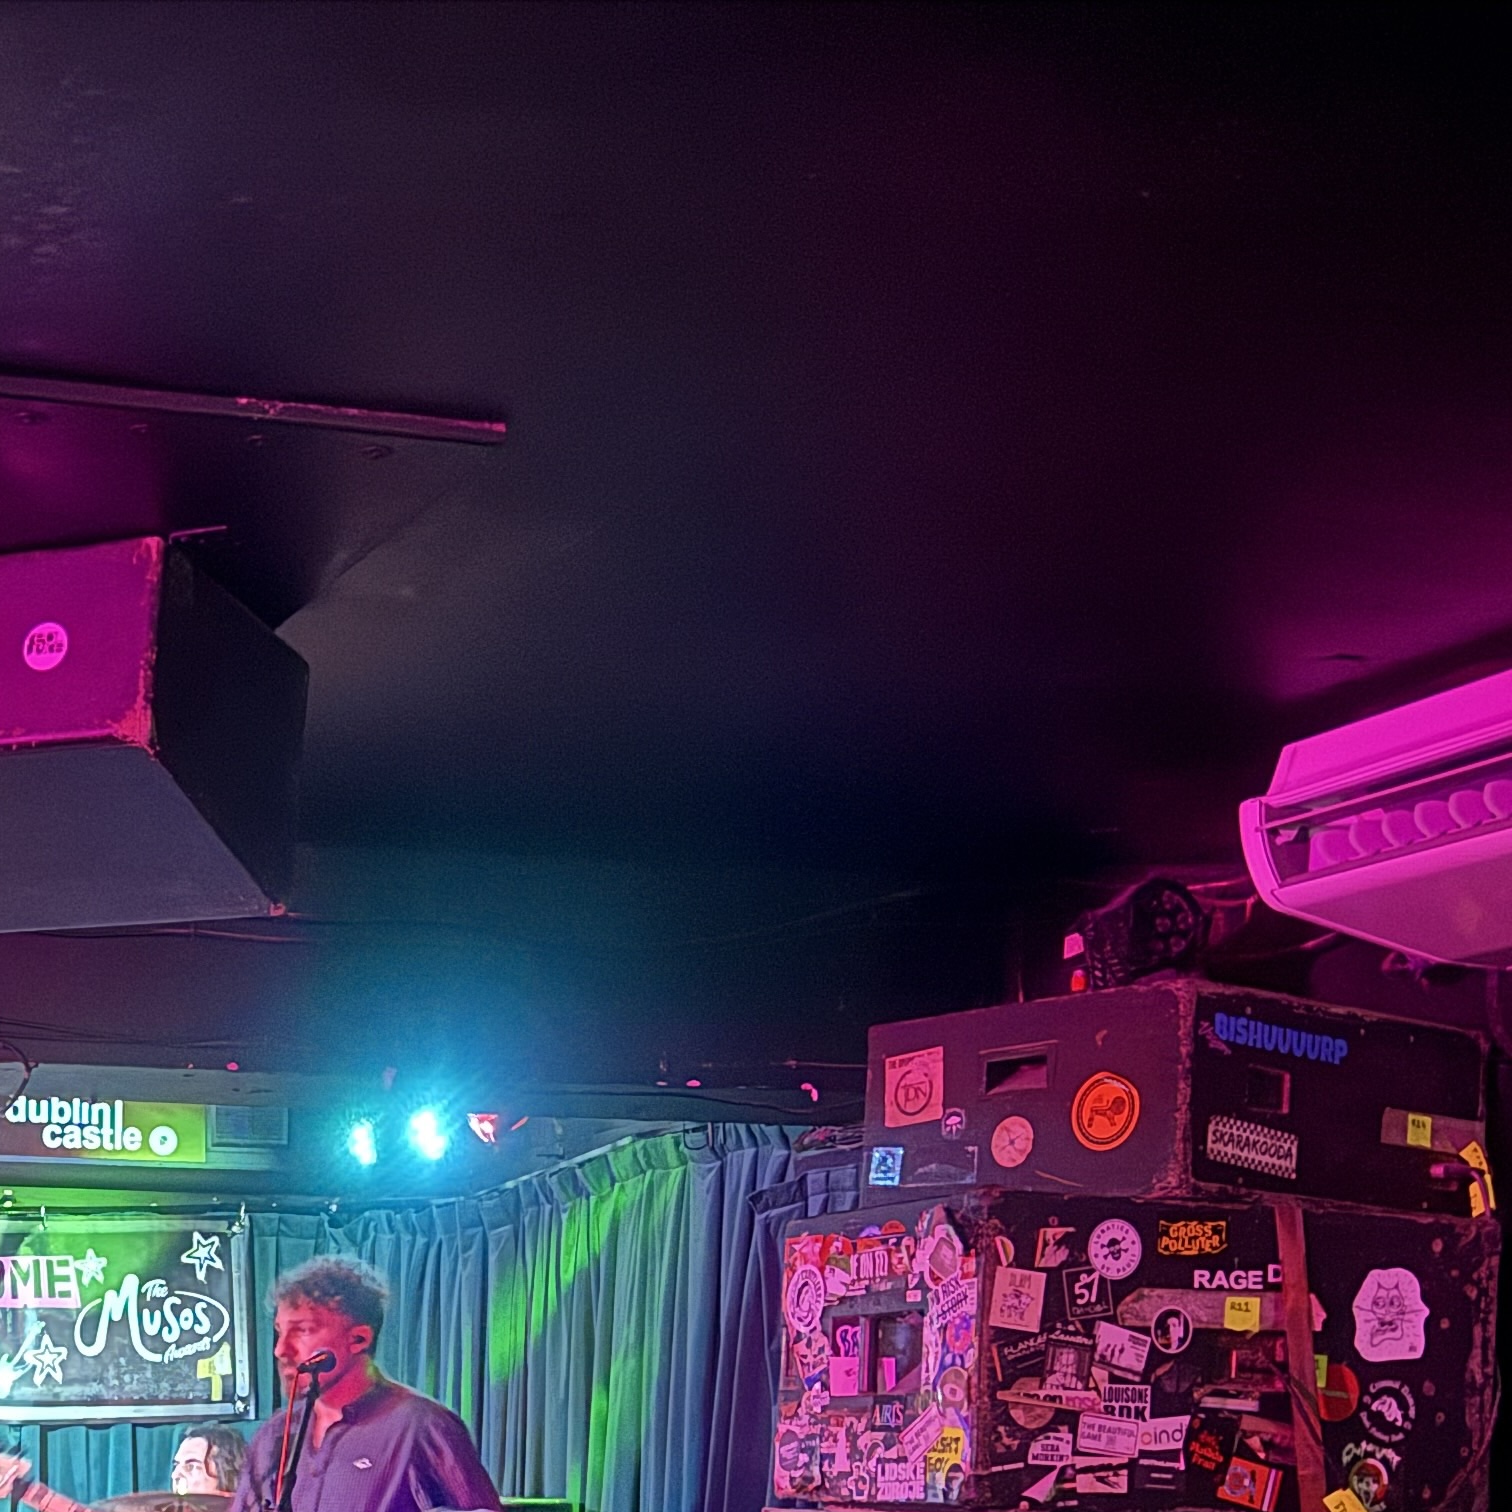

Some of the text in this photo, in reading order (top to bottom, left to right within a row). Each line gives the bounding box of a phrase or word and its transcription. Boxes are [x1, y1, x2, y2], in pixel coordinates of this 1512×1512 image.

[5, 1096, 110, 1125] dublin
[42, 1100, 143, 1151] castle
[1211, 1127, 1295, 1163] SKARAKOODA
[1169, 1224, 1213, 1238] GROSS
[1161, 1235, 1220, 1251] POLLUTER
[141, 1279, 169, 1300] The
[1194, 1269, 1264, 1289] RAGE
